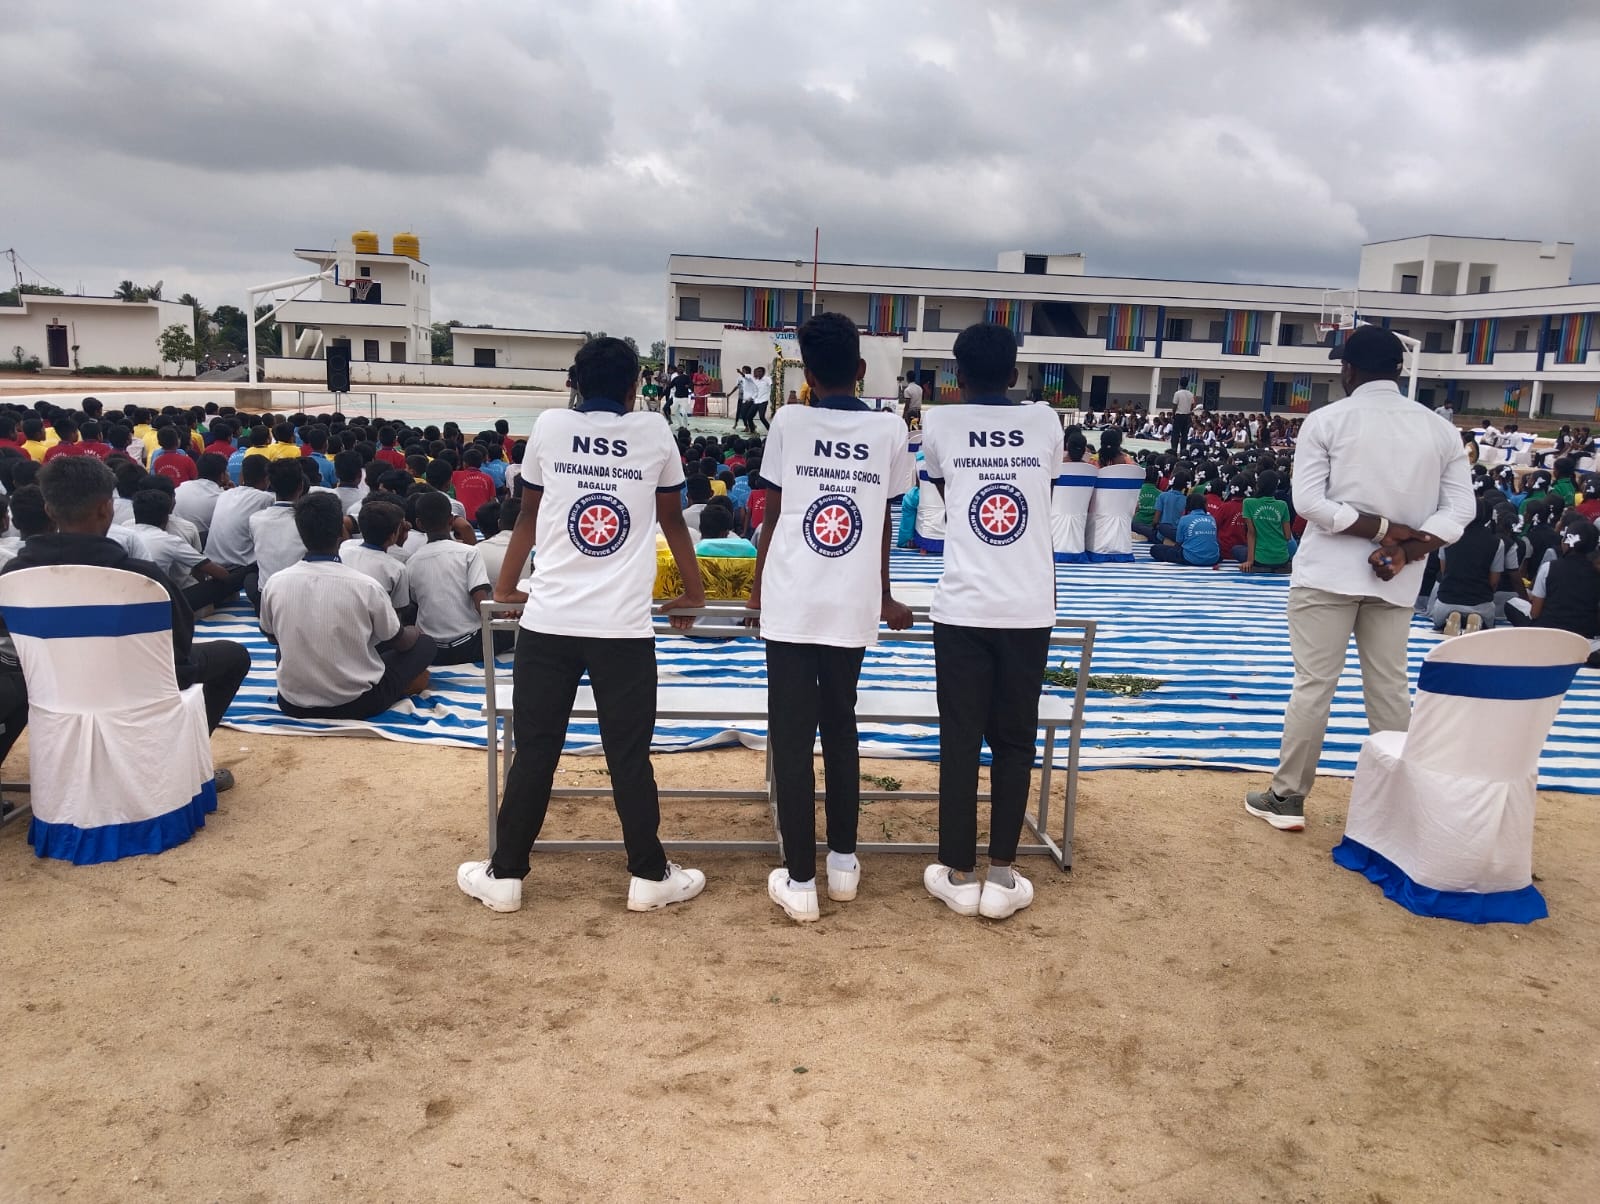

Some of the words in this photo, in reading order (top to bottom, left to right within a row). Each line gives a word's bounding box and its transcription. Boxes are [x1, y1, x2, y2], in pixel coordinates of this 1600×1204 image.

[969, 430, 1024, 447] NSS
[572, 435, 628, 457] NSS
[814, 439, 869, 460] NSS
[953, 457, 1009, 468] VIVEKANANDA
[1010, 457, 1041, 468] SCHOOL
[554, 462, 610, 478] VIVEKANANDA
[611, 467, 643, 480] SCHOOL
[796, 465, 851, 480] VIVEKANANDA
[852, 470, 881, 485] SCHOOL
[978, 472, 1017, 481] BAGALUR
[577, 481, 617, 491] BAGALUR
[819, 483, 856, 494] BAGALUR
[989, 536, 1015, 545] SERVICE
[583, 548, 611, 556] SERVICE
[819, 548, 844, 556] SERVICE
